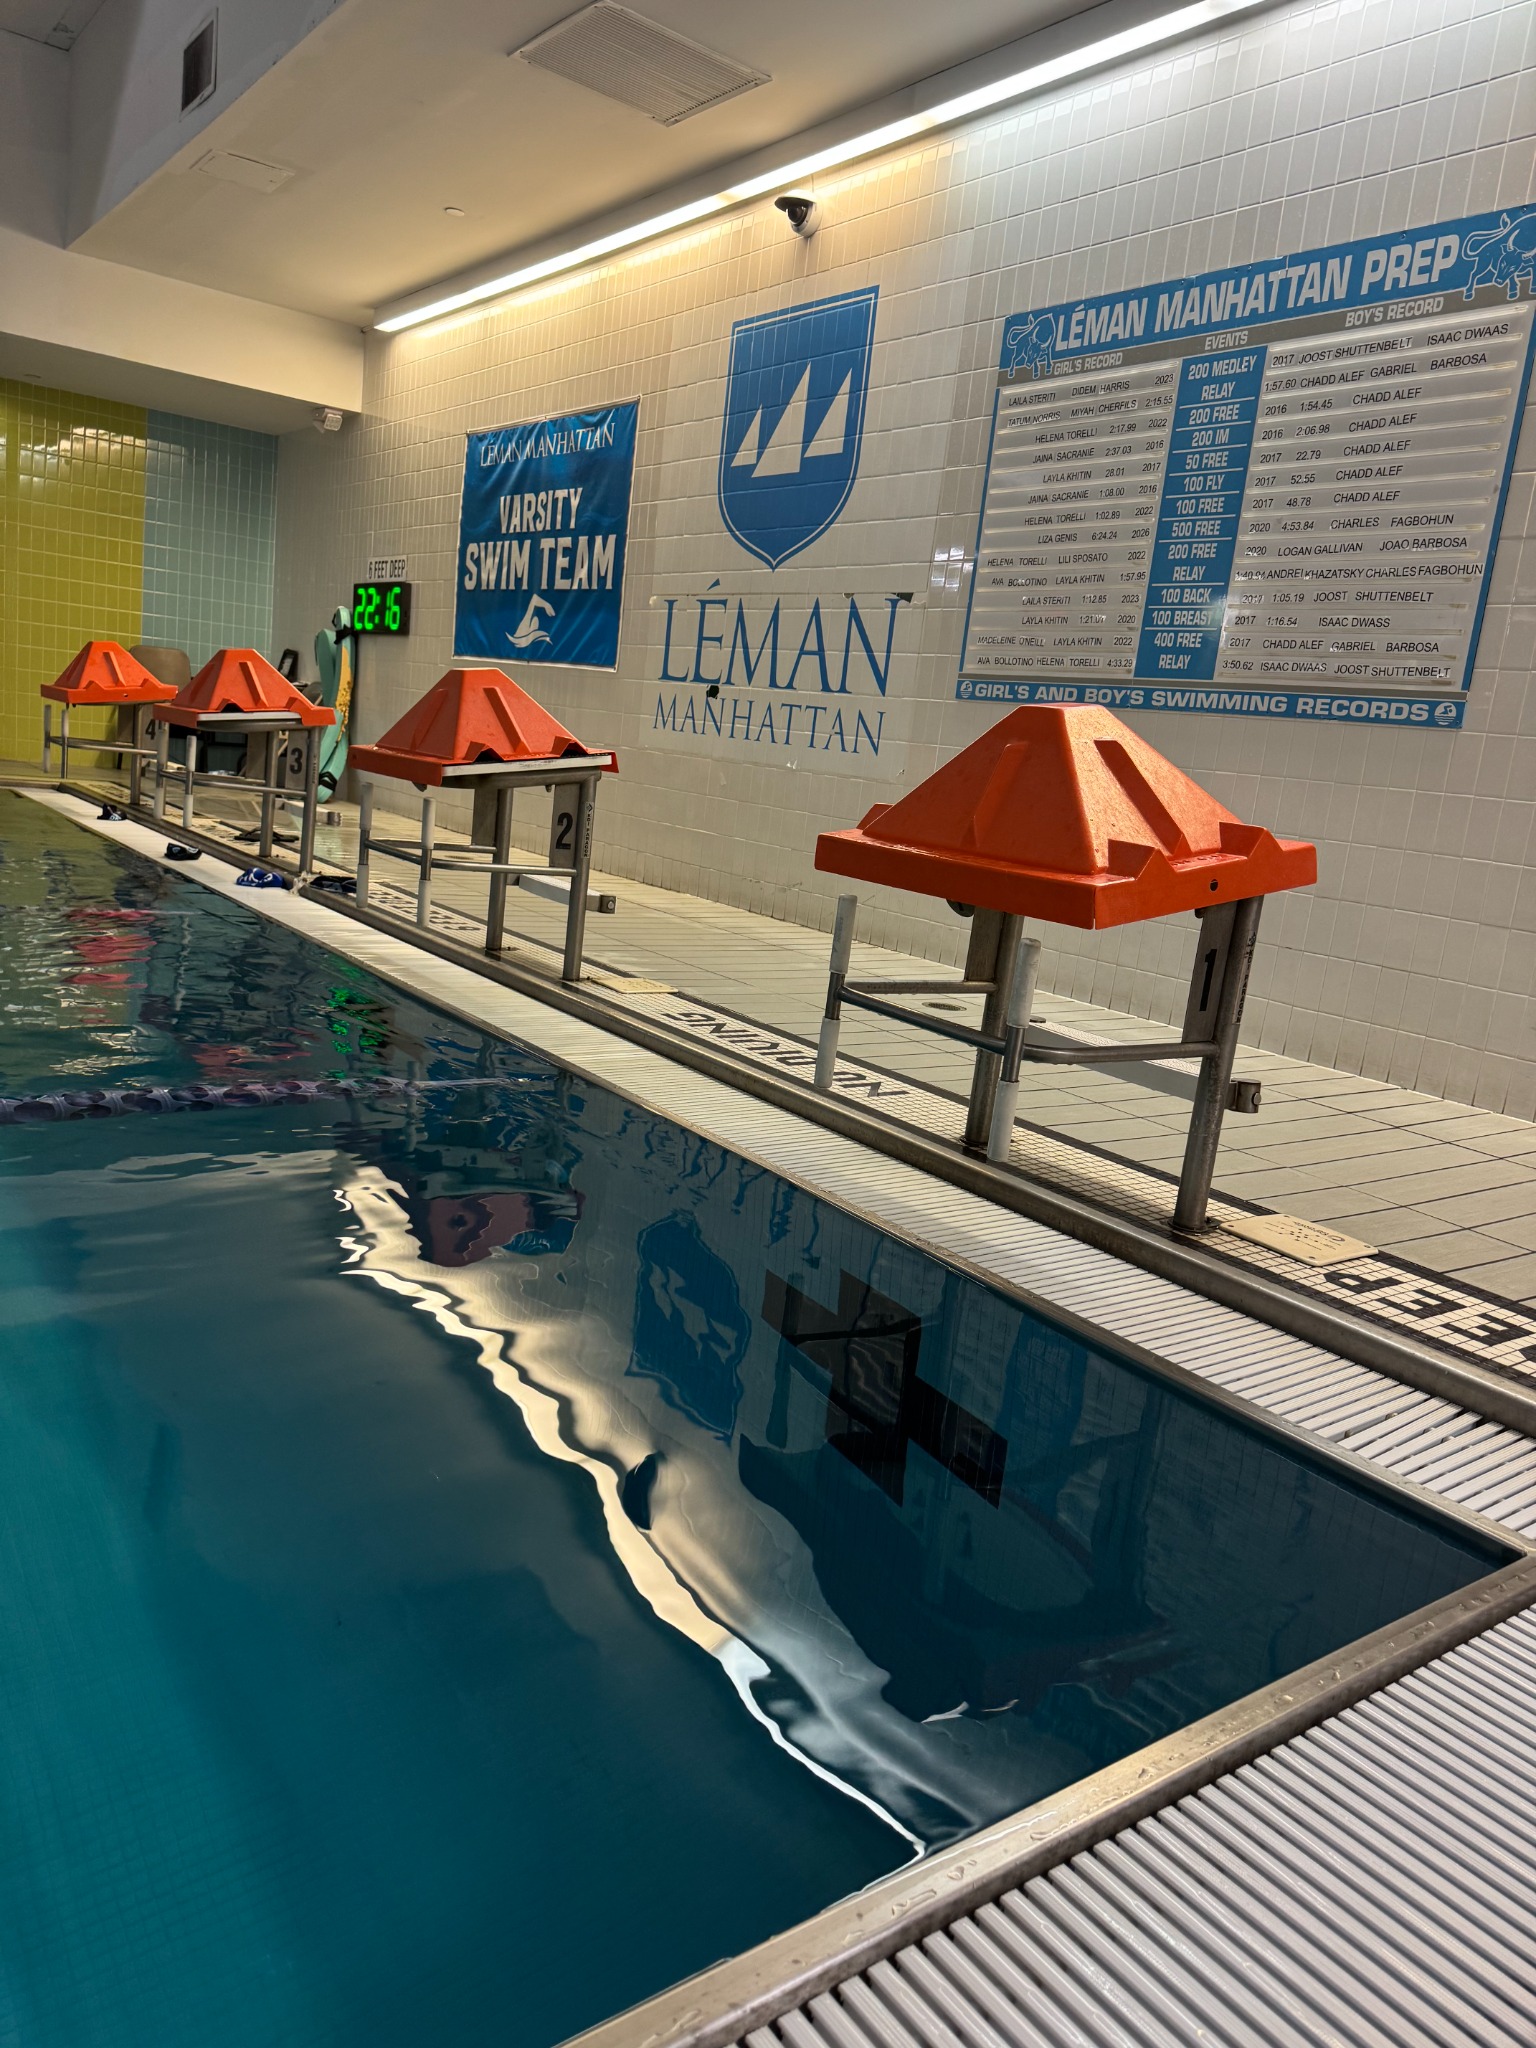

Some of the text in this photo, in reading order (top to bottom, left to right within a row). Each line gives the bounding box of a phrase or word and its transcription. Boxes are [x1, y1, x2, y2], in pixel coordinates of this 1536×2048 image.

[1054, 234, 1459, 352] LÉMAN MANHATTAN PREP
[1345, 297, 1444, 327] BOY'S RECORD
[1204, 332, 1248, 351] EVENTS
[1273, 324, 1509, 366] 2017 JOOST SHUTTENBELT ISAAC DWAAS
[1054, 353, 1123, 375] GIRL'S RECORD
[1188, 355, 1257, 380] 200 MEDLEY
[1300, 353, 1487, 388] CHADD ALEF GABRIEL BARBOSA
[1072, 374, 1173, 396] DIDEM HARRIS 2023
[1201, 382, 1235, 400] RELAY
[1070, 406, 1094, 417] MIYAH
[1265, 388, 1422, 416] 2016 1:54.45 CHADD ALEF
[1189, 404, 1240, 425] 200 FREE
[1035, 419, 1168, 443] HELENA 2022
[1262, 413, 1417, 440] 2016 CHADD ALEF
[480, 423, 615, 466] LÉMAN MANHATTAN
[1192, 428, 1229, 446] 200 IM
[1056, 440, 1164, 461] SACRANIE 2016
[1260, 440, 1411, 464] 2017 22.79 CHADD ALEF
[1185, 452, 1228, 469] 50 FREE
[1043, 463, 1161, 483] LAYLA 2017
[1255, 465, 1403, 486] 2017 52.55 CHADD ALEF
[1052, 484, 1157, 502] SACRANIE 2016
[1184, 475, 1225, 492] 100 FLY
[1176, 498, 1224, 515] 100 FREE
[1253, 491, 1400, 508] 2017 CHADD ALEF
[500, 487, 583, 533] VARSITY
[1025, 506, 1153, 525] HELENA TORELLI 2022
[1172, 520, 1221, 537] 500 FREE
[1249, 514, 1454, 533] 2020 4:53.84 CHARLES FAGBOHUN
[1055, 533, 1077, 542] GENIS
[1278, 537, 1467, 557] LOGAN GALLIVAN JOAO BARBOSA
[988, 551, 1146, 566] HELENA TORELLI LILI SPOSATO 2022
[1168, 543, 1217, 559] 200 FREE
[369, 560, 405, 579] 6 FEET DEEP
[464, 534, 616, 590] SWIM TEAM
[1266, 564, 1483, 579] ANDREI KHAZATSKY CHARLES FAGBOHUN
[1055, 575, 1078, 584] LAYLA
[1079, 574, 1105, 583] KHITIN
[1120, 572, 1146, 581] 1:57.95
[1173, 566, 1205, 581] RELAY
[1122, 595, 1139, 603] 2023
[1161, 588, 1212, 603] 100 BACK
[1273, 591, 1433, 602] 1:05.19 JOOST SHUTTENBELT
[354, 587, 401, 630] 22:16
[1152, 610, 1213, 625] 100 BREAST
[1118, 615, 1136, 623] 2020
[1235, 616, 1390, 627] 2017 ISAAC DWASS
[658, 578, 901, 697] LÉMAN
[1154, 633, 1202, 648] 400 FREE
[1230, 638, 1439, 652] 2017 CHADD ALEF GABRIEL BARBOSA
[978, 657, 1132, 667] AVA BOLLOTINO HELENA TORELLI 4:33.29
[1159, 655, 1191, 669] RELAY
[1223, 660, 1369, 674] 3:50.62 ISAAC DWAAS JOOST
[974, 684, 1430, 721] GIRL'S AND BOY'S SWIMMING RECORDS
[145, 719, 156, 740] 4
[653, 692, 886, 756] MANHATTAN
[289, 748, 303, 775] 3
[556, 812, 573, 850] 2
[1199, 949, 1217, 1011] 1
[662, 1012, 822, 1066] DIVING
[1323, 1273, 1536, 1361] EEP
